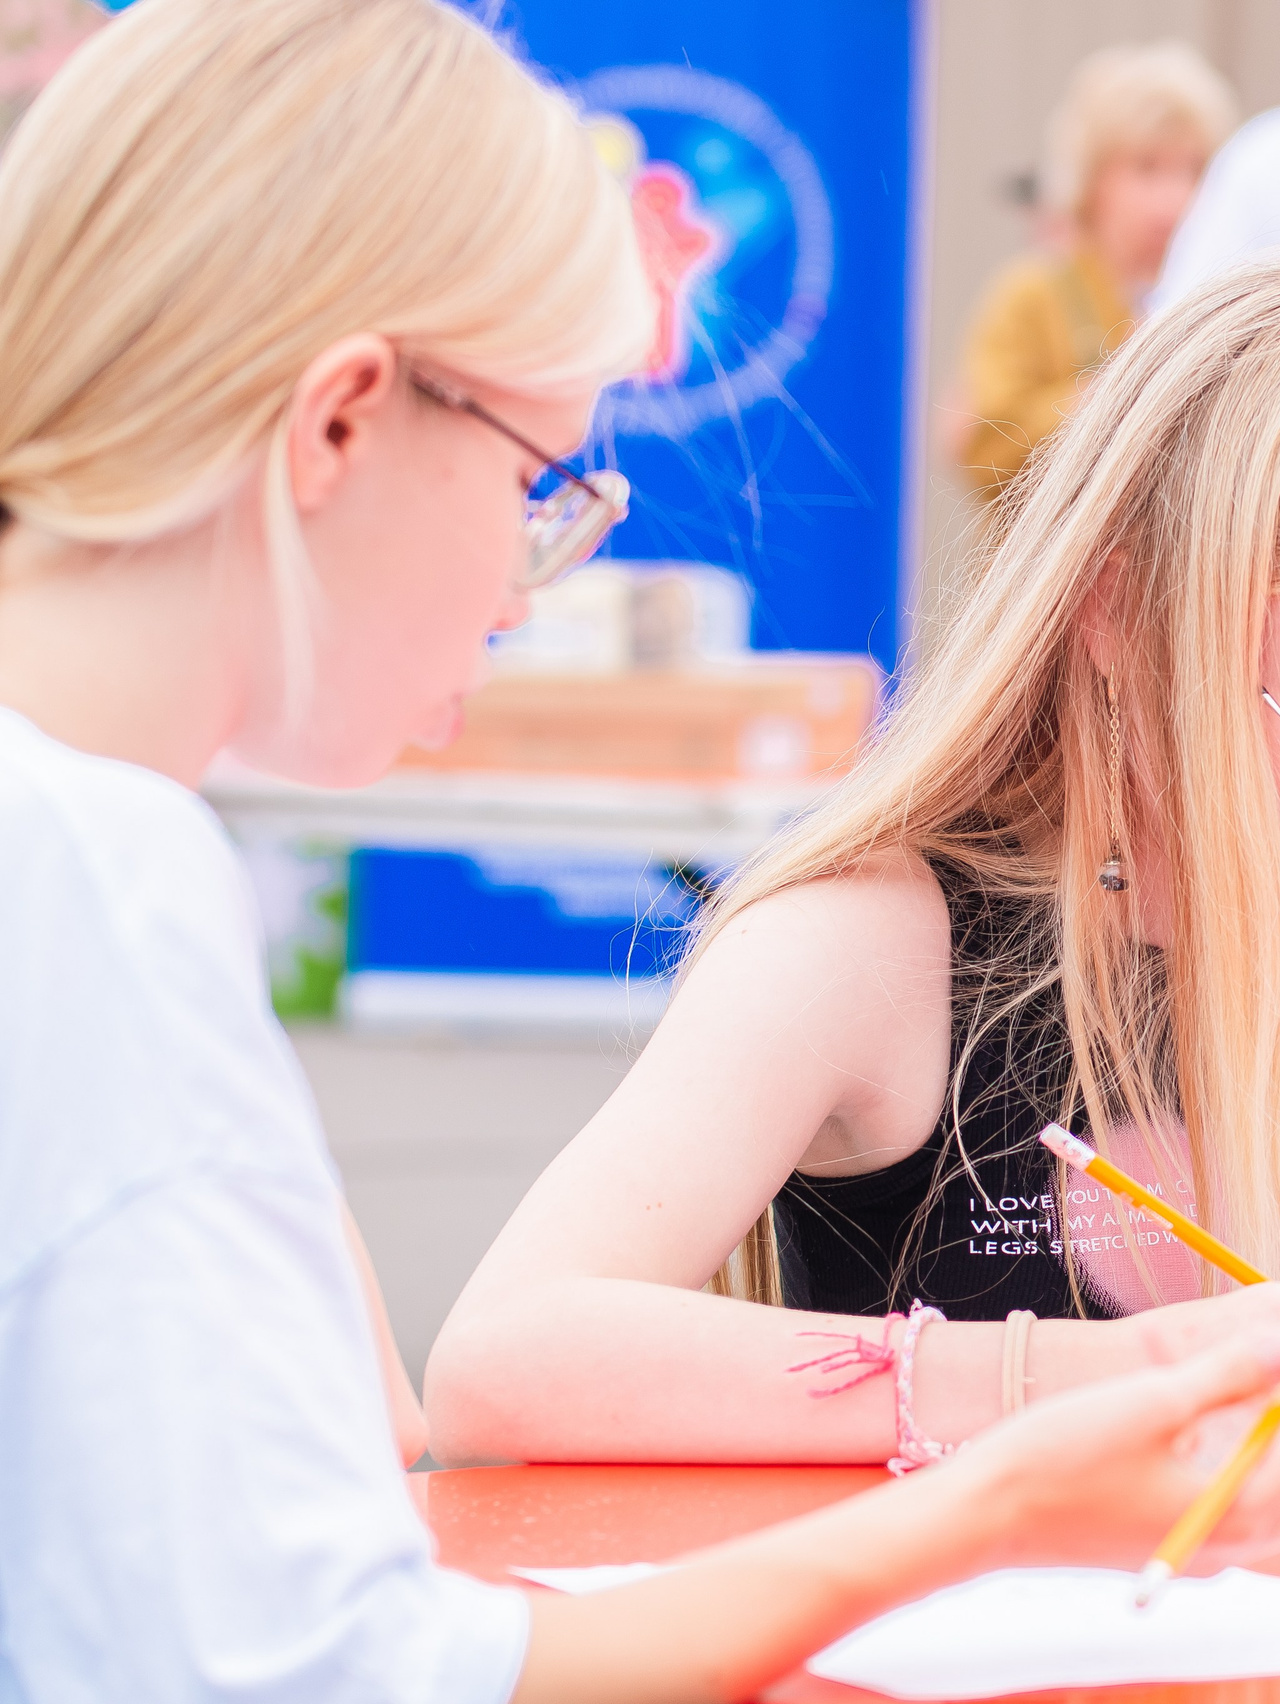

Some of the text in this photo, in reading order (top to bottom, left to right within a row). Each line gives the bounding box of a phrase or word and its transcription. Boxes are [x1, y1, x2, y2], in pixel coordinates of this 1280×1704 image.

[969, 1198, 975, 1212] I
[985, 1194, 1055, 1212] LOVE
[1061, 1187, 1100, 1205] YOU
[970, 1218, 1052, 1235] WITH
[1066, 1213, 1096, 1231] MY
[969, 1240, 1039, 1255] LEGS
